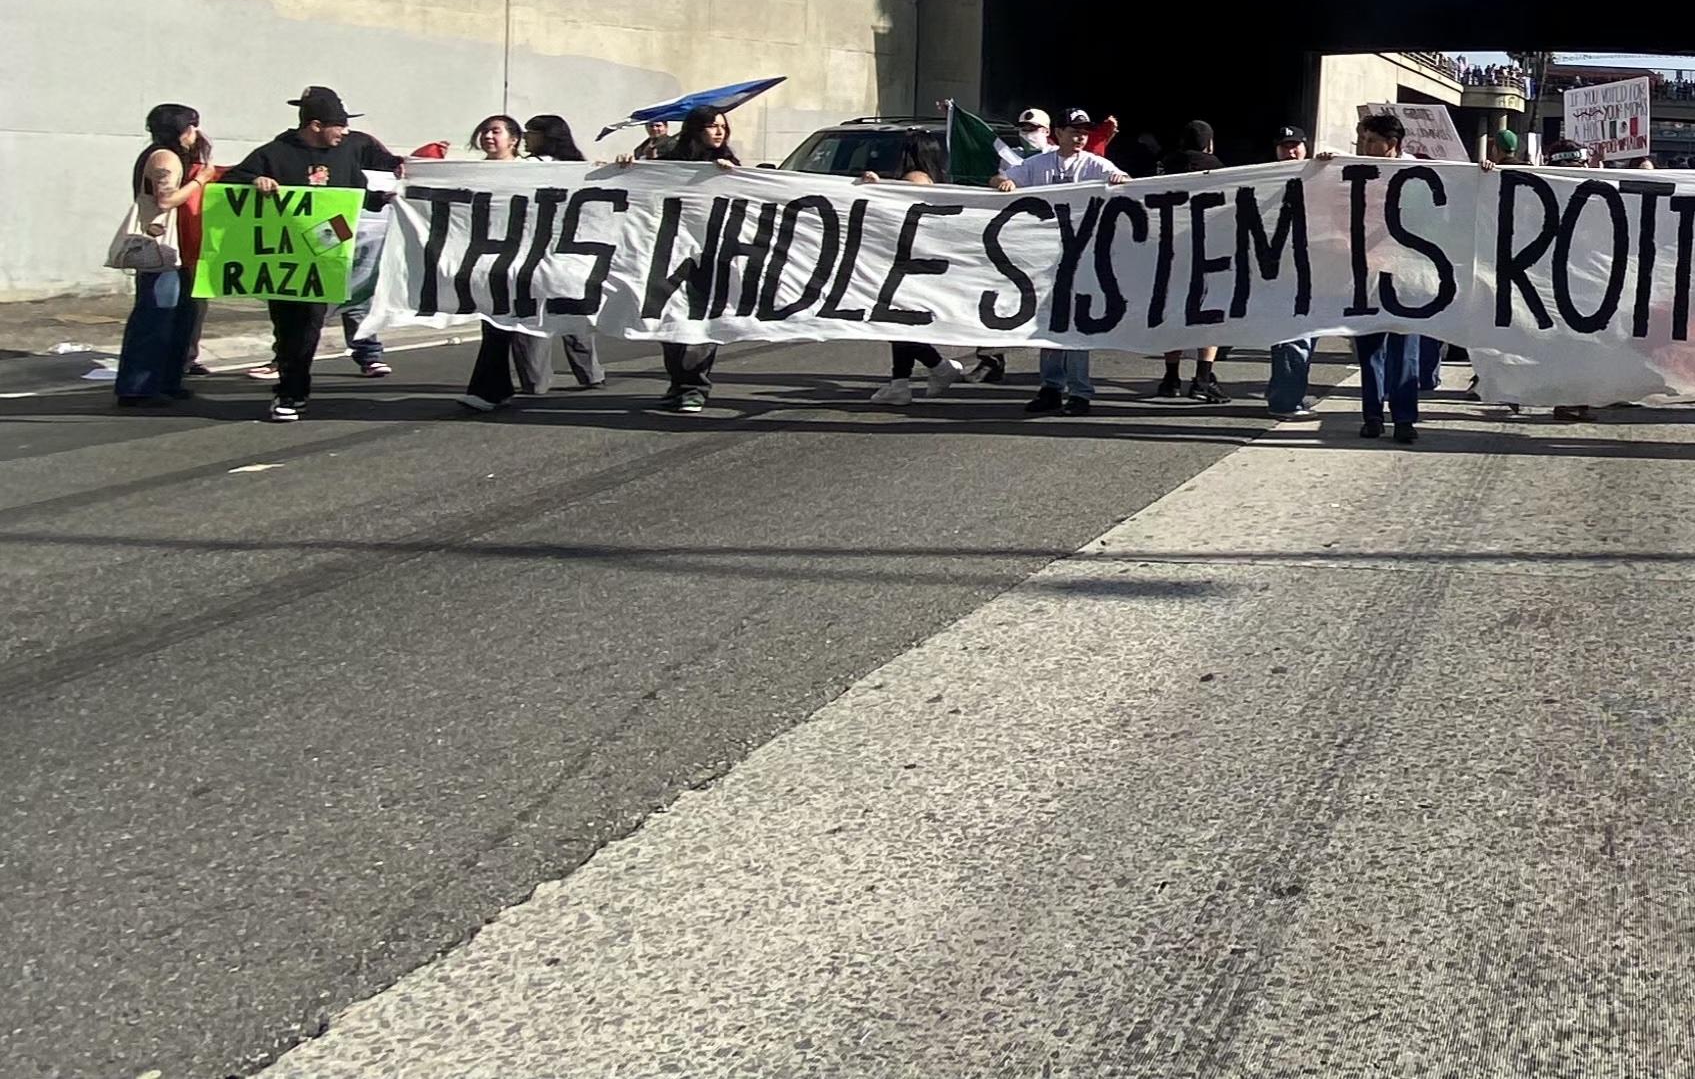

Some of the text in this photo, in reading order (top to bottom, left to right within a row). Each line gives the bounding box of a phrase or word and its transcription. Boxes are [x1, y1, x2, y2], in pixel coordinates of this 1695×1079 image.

[1570, 92, 1580, 107] IF
[1583, 89, 1598, 106] YOU
[224, 187, 313, 219] VIVA
[254, 225, 294, 256] LA
[406, 186, 629, 317] THIS
[640, 194, 964, 323] WHOLE
[978, 177, 1313, 335] SYSTEM
[1341, 164, 1457, 320] IS
[222, 261, 325, 298] RAZA
